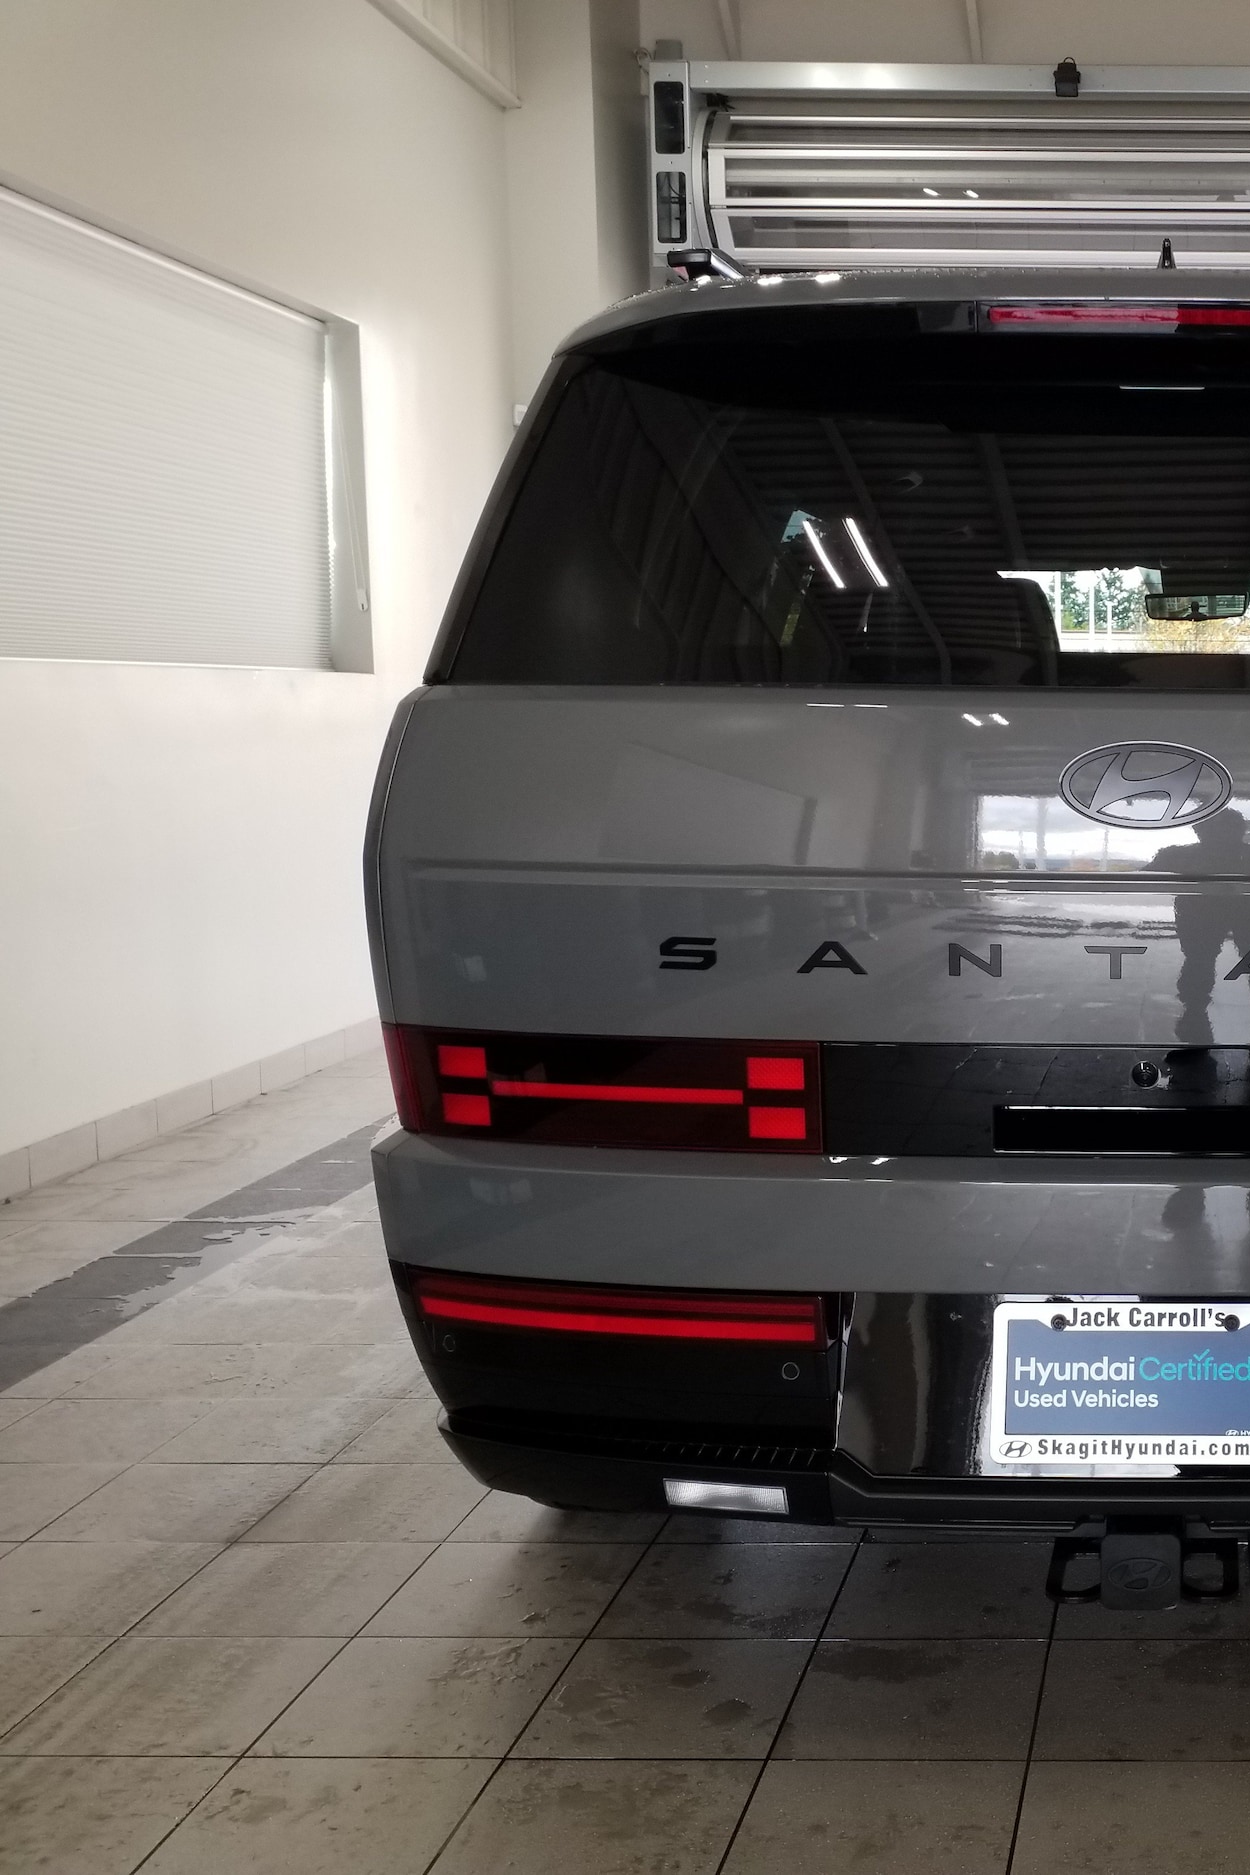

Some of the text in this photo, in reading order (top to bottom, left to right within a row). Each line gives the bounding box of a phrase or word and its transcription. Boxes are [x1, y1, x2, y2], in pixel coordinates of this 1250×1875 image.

[1066, 1307, 1226, 1329] Jack Carroll's
[1014, 1356, 1135, 1386] Hyundai
[1014, 1389, 1159, 1408] Used Vehicles
[1037, 1439, 1250, 1460] SkagitHyundai.com
